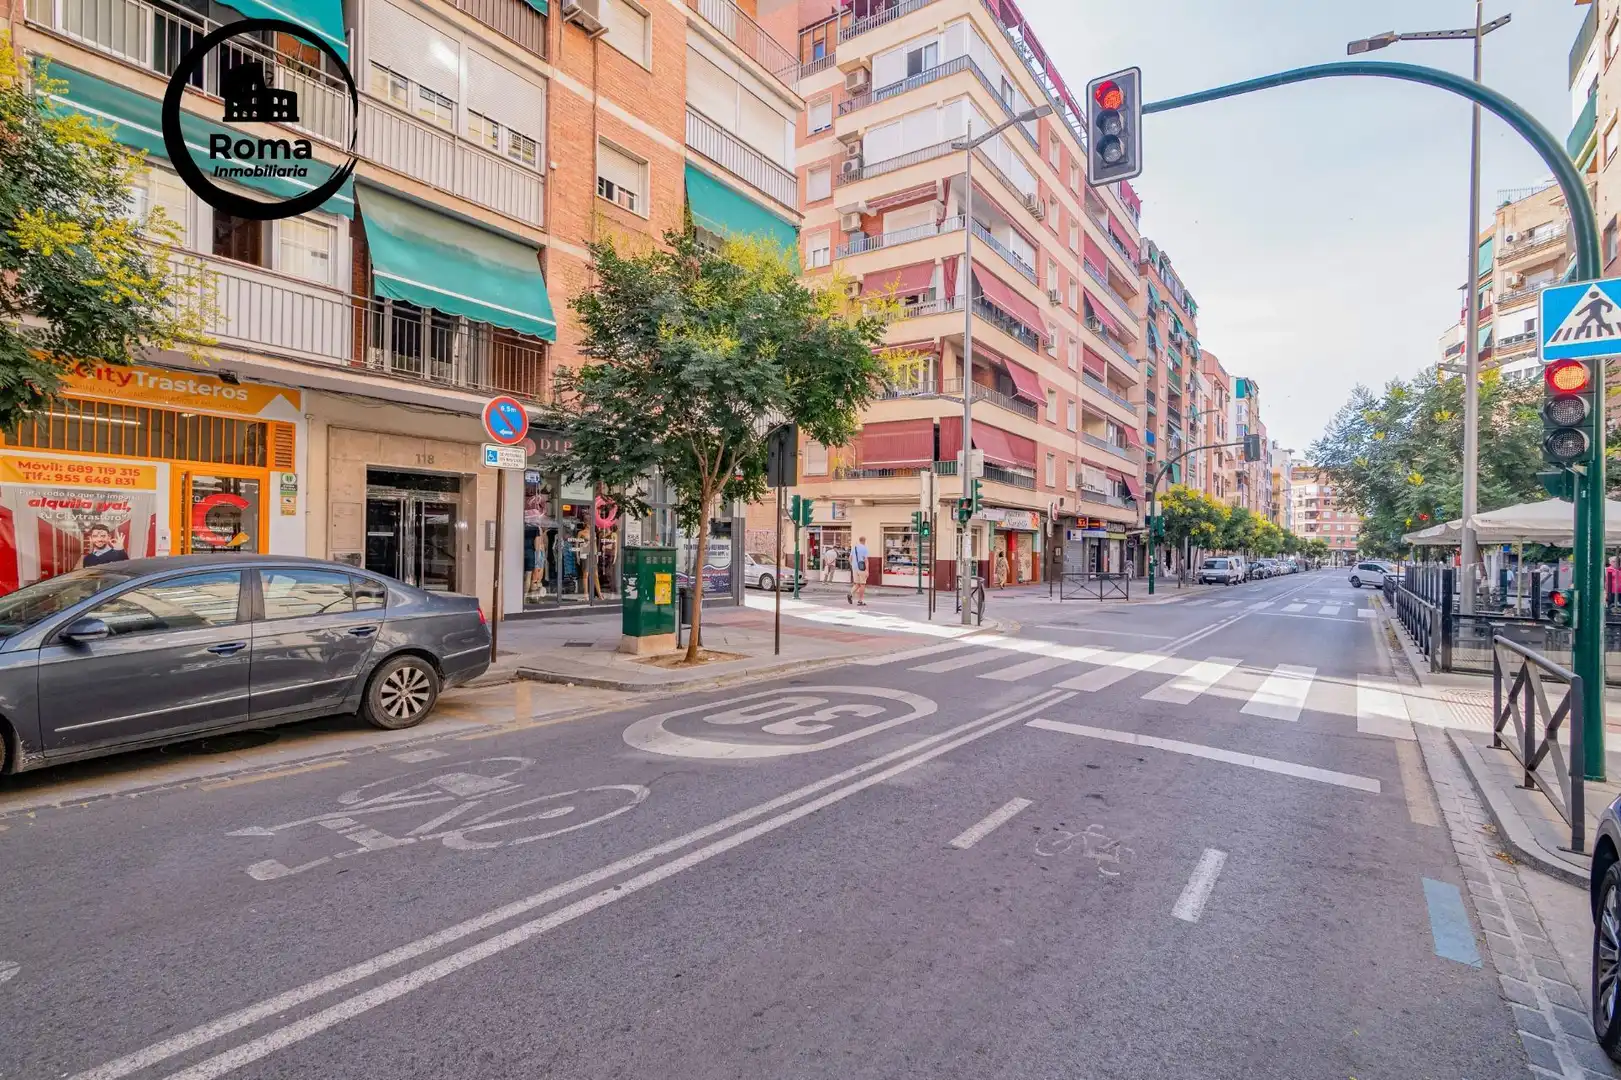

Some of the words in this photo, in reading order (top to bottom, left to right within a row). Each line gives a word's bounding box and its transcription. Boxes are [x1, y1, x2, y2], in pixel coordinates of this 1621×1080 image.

[415, 453, 435, 465] 118
[18, 460, 63, 472] Móvil:
[67, 464, 94, 474] 689
[98, 466, 116, 475] 119
[119, 468, 141, 477] 315
[54, 474, 80, 483] 955
[84, 476, 111, 485] 648
[115, 478, 136, 486] 831
[28, 497, 92, 510] alquila
